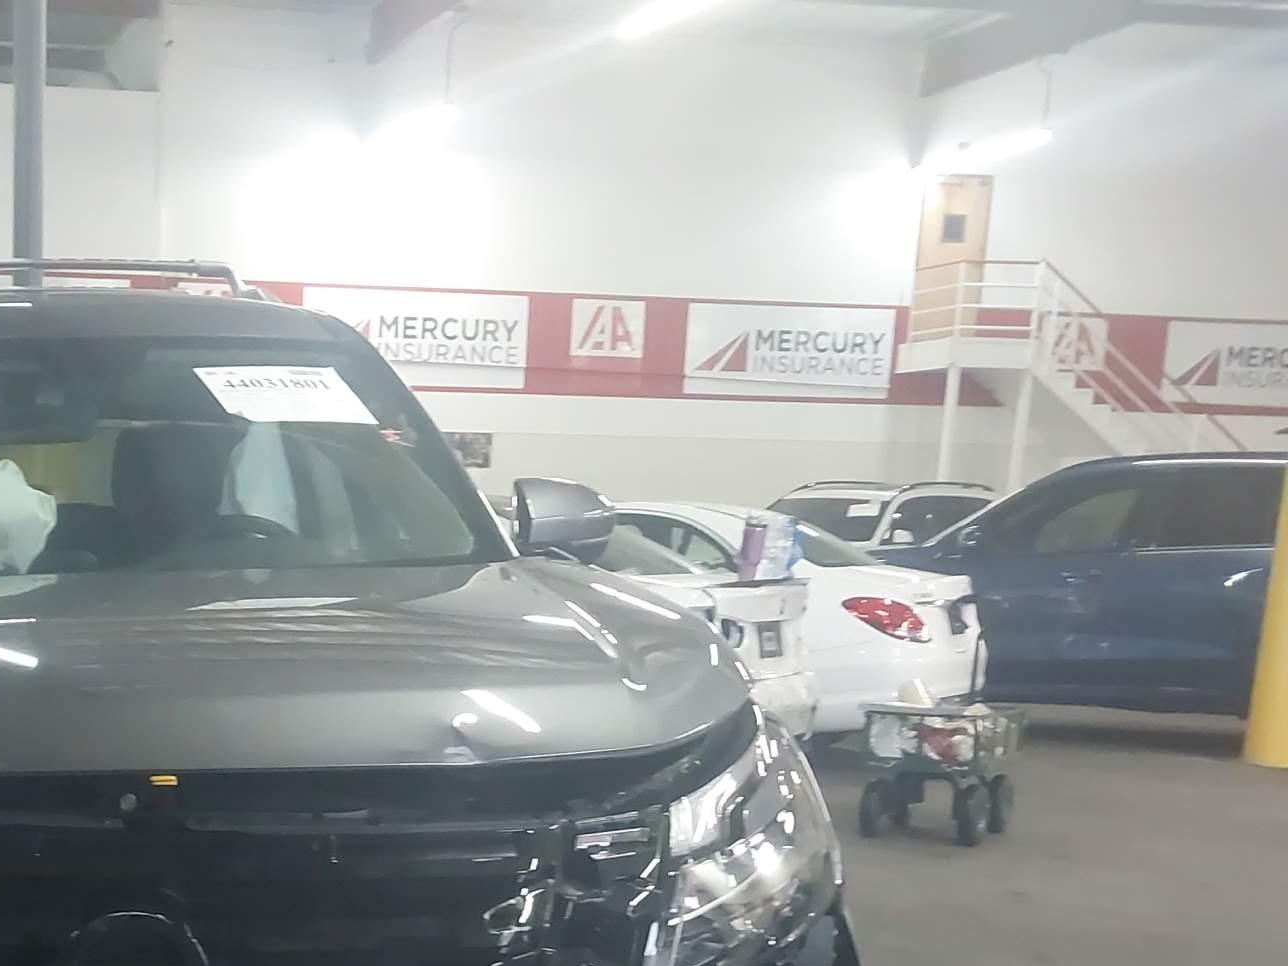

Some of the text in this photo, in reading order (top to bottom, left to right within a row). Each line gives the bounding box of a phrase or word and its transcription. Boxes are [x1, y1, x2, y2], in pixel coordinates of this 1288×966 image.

[378, 315, 520, 342] MERCURY
[754, 328, 886, 355] MERCURY
[753, 354, 884, 376] INSURANCE
[223, 378, 330, 391] 44031801
